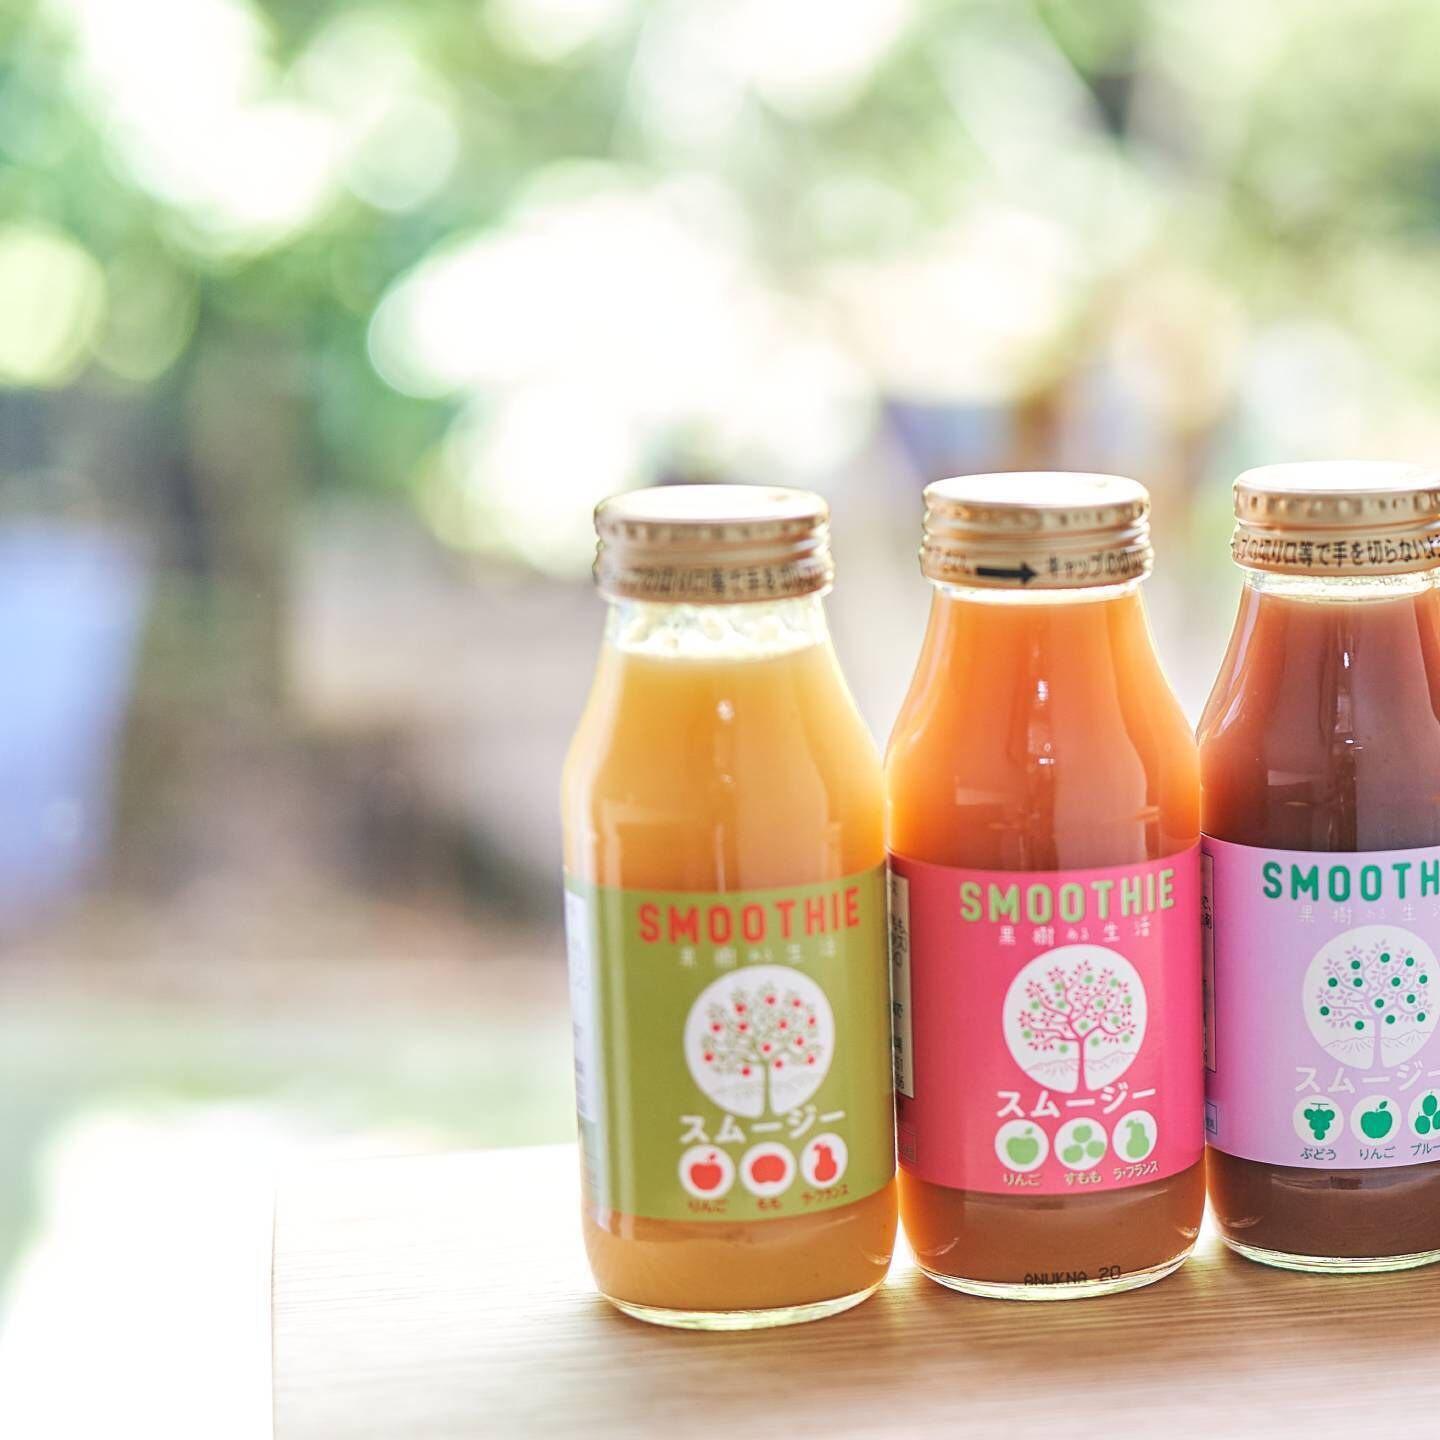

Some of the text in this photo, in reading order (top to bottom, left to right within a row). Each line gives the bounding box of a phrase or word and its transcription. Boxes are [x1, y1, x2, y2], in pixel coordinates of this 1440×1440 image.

[638, 885, 861, 945] SMOOTHIE
[959, 868, 1175, 925] SMOOTHIE
[996, 1082, 1157, 1119] スムージー
[679, 1104, 846, 1144] スムージー
[1301, 1147, 1338, 1161] ぶどう
[1359, 1146, 1397, 1161] りんご
[1003, 1160, 1159, 1186] りんご すもも ラ・フランス
[1098, 1265, 1121, 1281] 20
